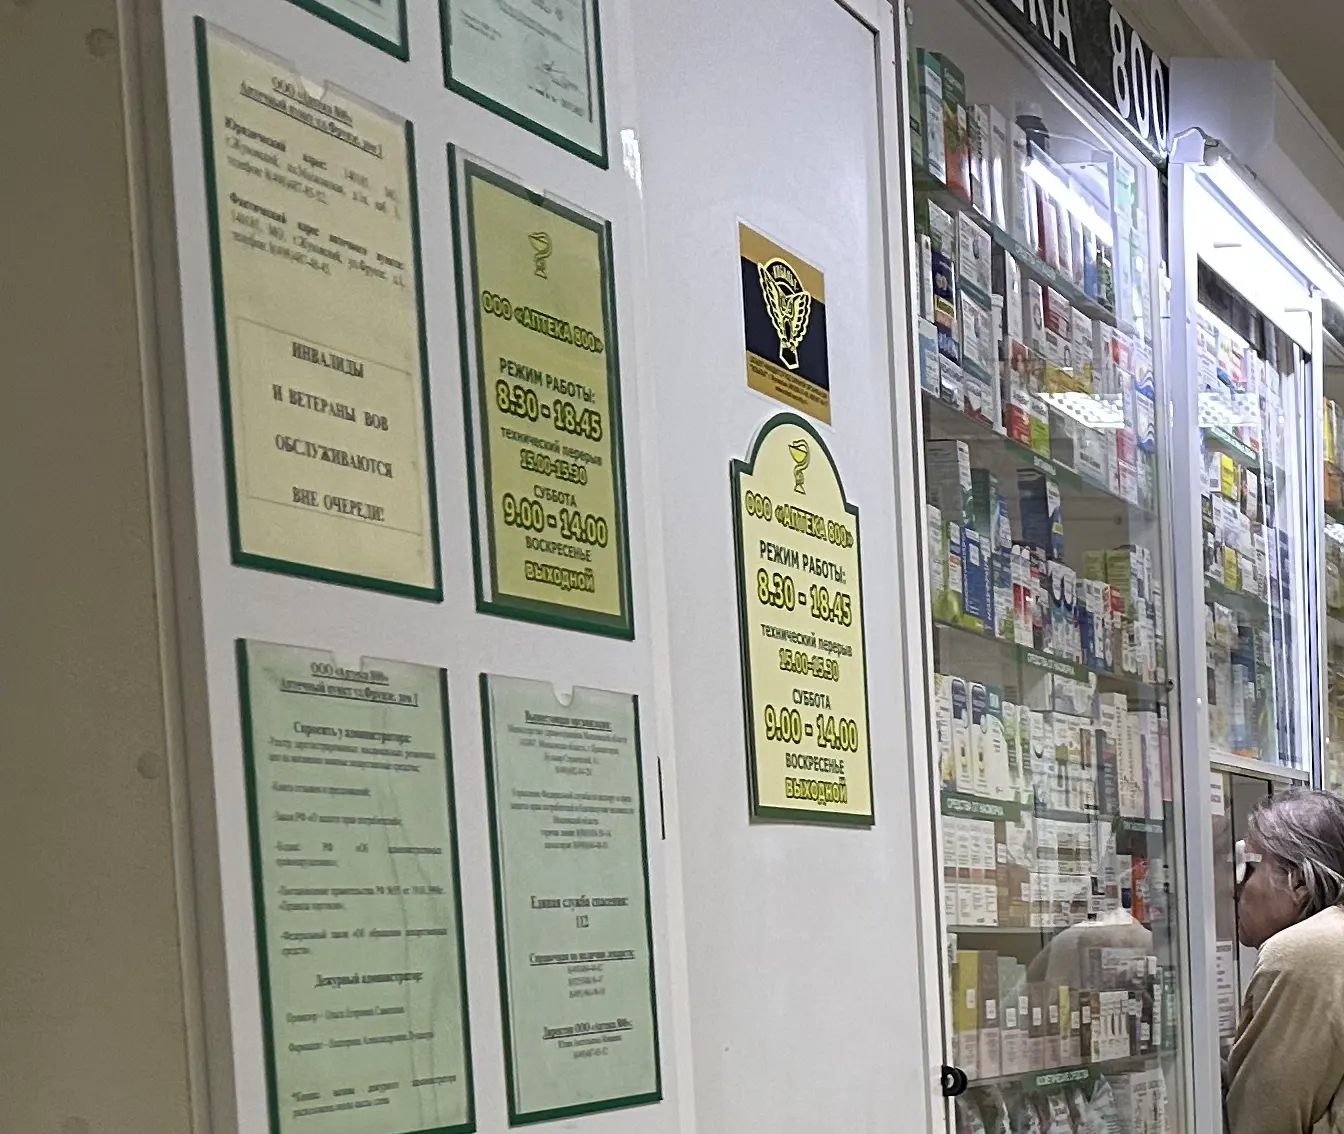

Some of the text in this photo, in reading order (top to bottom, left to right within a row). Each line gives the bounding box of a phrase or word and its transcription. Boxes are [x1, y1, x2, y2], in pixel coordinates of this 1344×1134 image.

[1109, 6, 1168, 158] 800
[482, 290, 512, 320] ООО
[291, 341, 364, 379] ИНВАЛИДЫ
[499, 357, 596, 404] РЕЖИМ РАБОТЫ:
[272, 384, 389, 431] И ВЕТЕРАНЫ ВОВ
[496, 379, 539, 422] 8.30
[553, 398, 603, 442] 18.45
[275, 434, 393, 479] ОБСЛУЖИВАЮТСЯ
[292, 486, 385, 522] ВНЕ ОЧЕРЕДИ!
[533, 484, 577, 507] СУББОТА
[745, 490, 773, 522] ООО
[774, 504, 827, 541] «АПТЕКА
[502, 493, 545, 533] 9.00
[559, 507, 609, 549] 14.00
[525, 536, 592, 562] ВОСКРЕСЕНЬЕ
[759, 540, 847, 584] РЕЖИМ РАБОТЫ:
[524, 559, 595, 593] ВЫХОДНОЙ
[757, 567, 795, 611] 8.30
[809, 583, 852, 627] 18.45
[760, 623, 853, 657] технический перерыв
[792, 688, 831, 710] СУББОТА
[764, 704, 802, 745] 9.00
[816, 713, 858, 753] 14.00
[785, 752, 845, 775] ВОСКРЕСЕНЬЕ
[785, 776, 848, 806] ВЫХОДНОЙ
